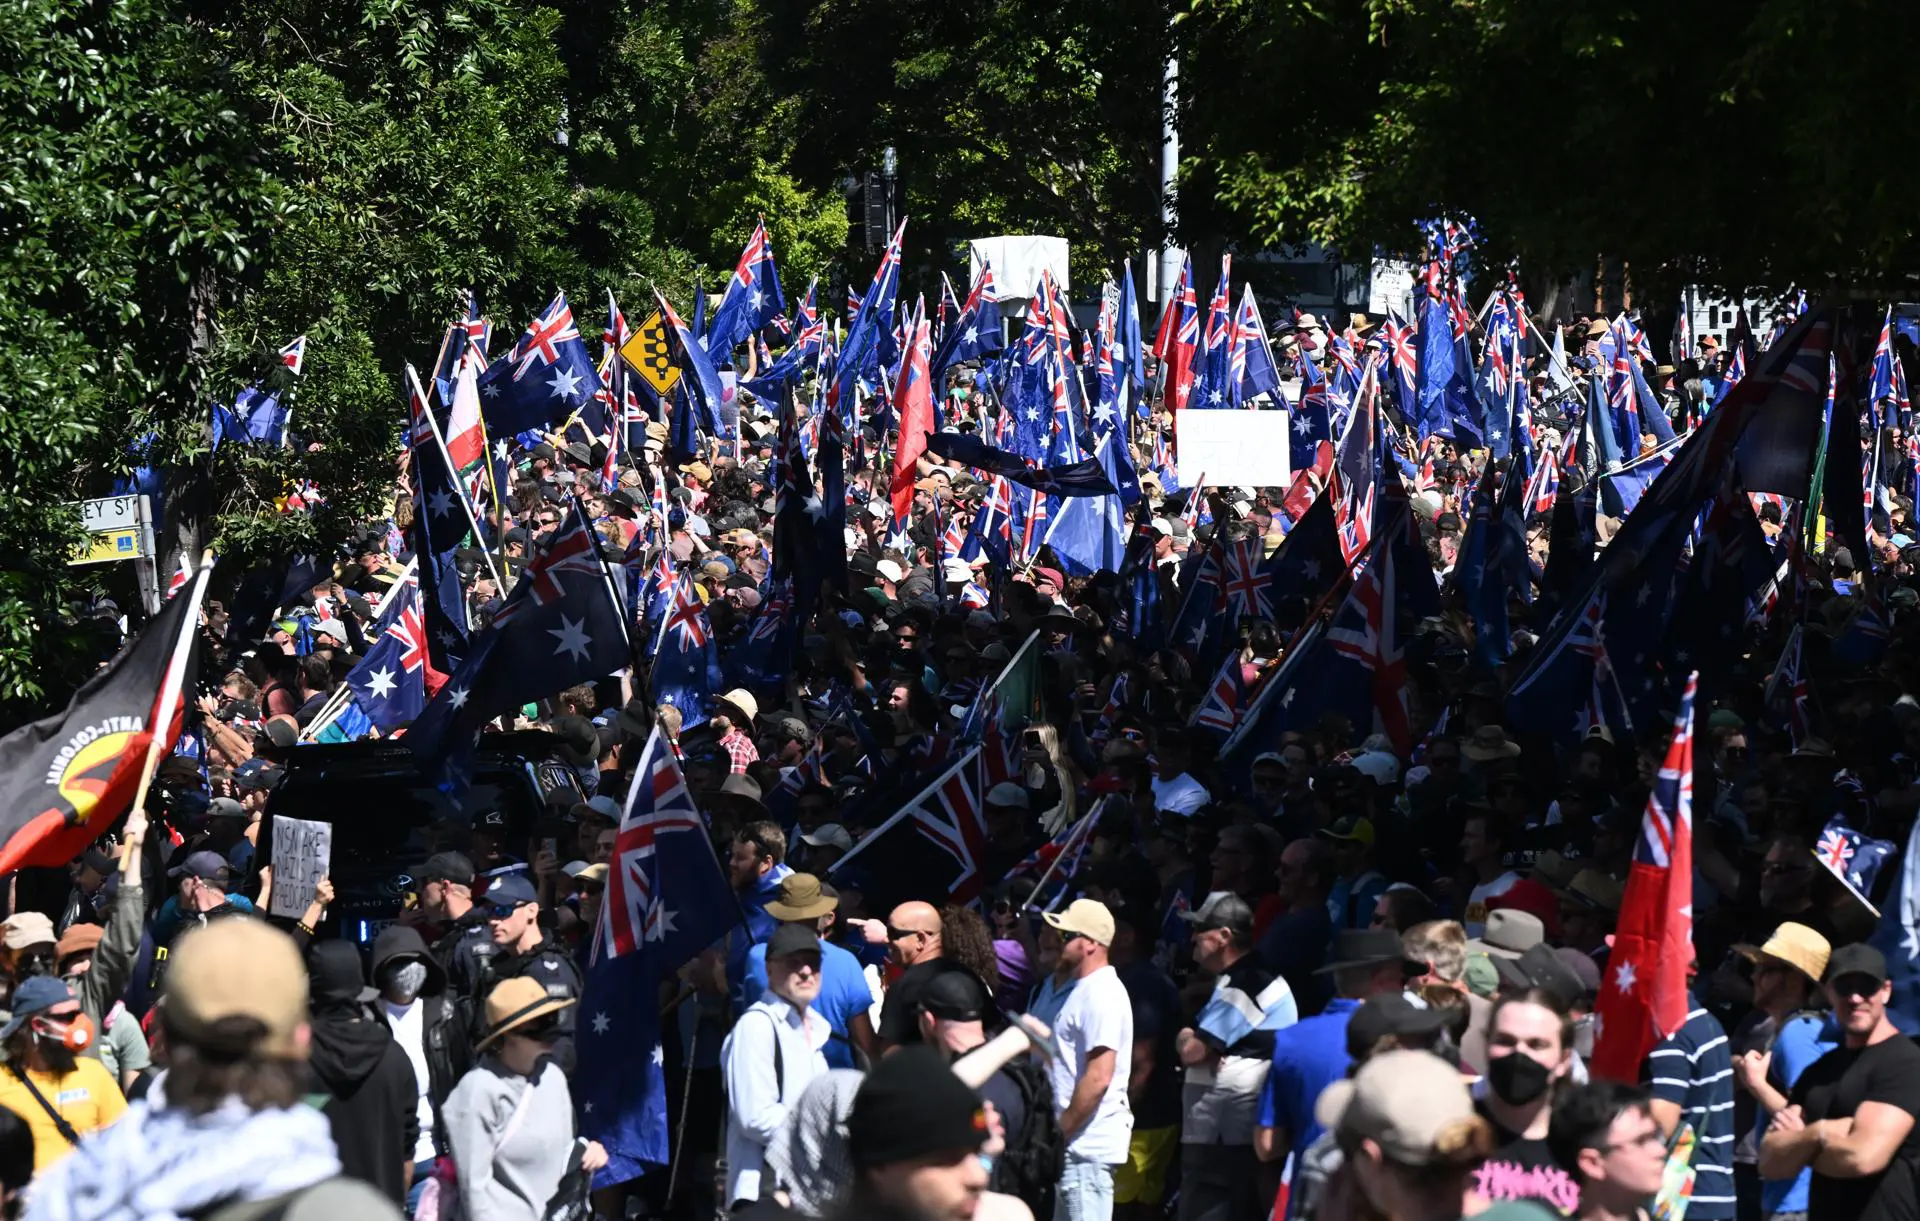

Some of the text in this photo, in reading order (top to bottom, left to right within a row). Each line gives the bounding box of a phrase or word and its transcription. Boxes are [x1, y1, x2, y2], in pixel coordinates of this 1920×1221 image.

[84, 497, 130, 519] EY ST
[275, 825, 324, 857] NSN ARE
[275, 856, 306, 883] NAZIS
